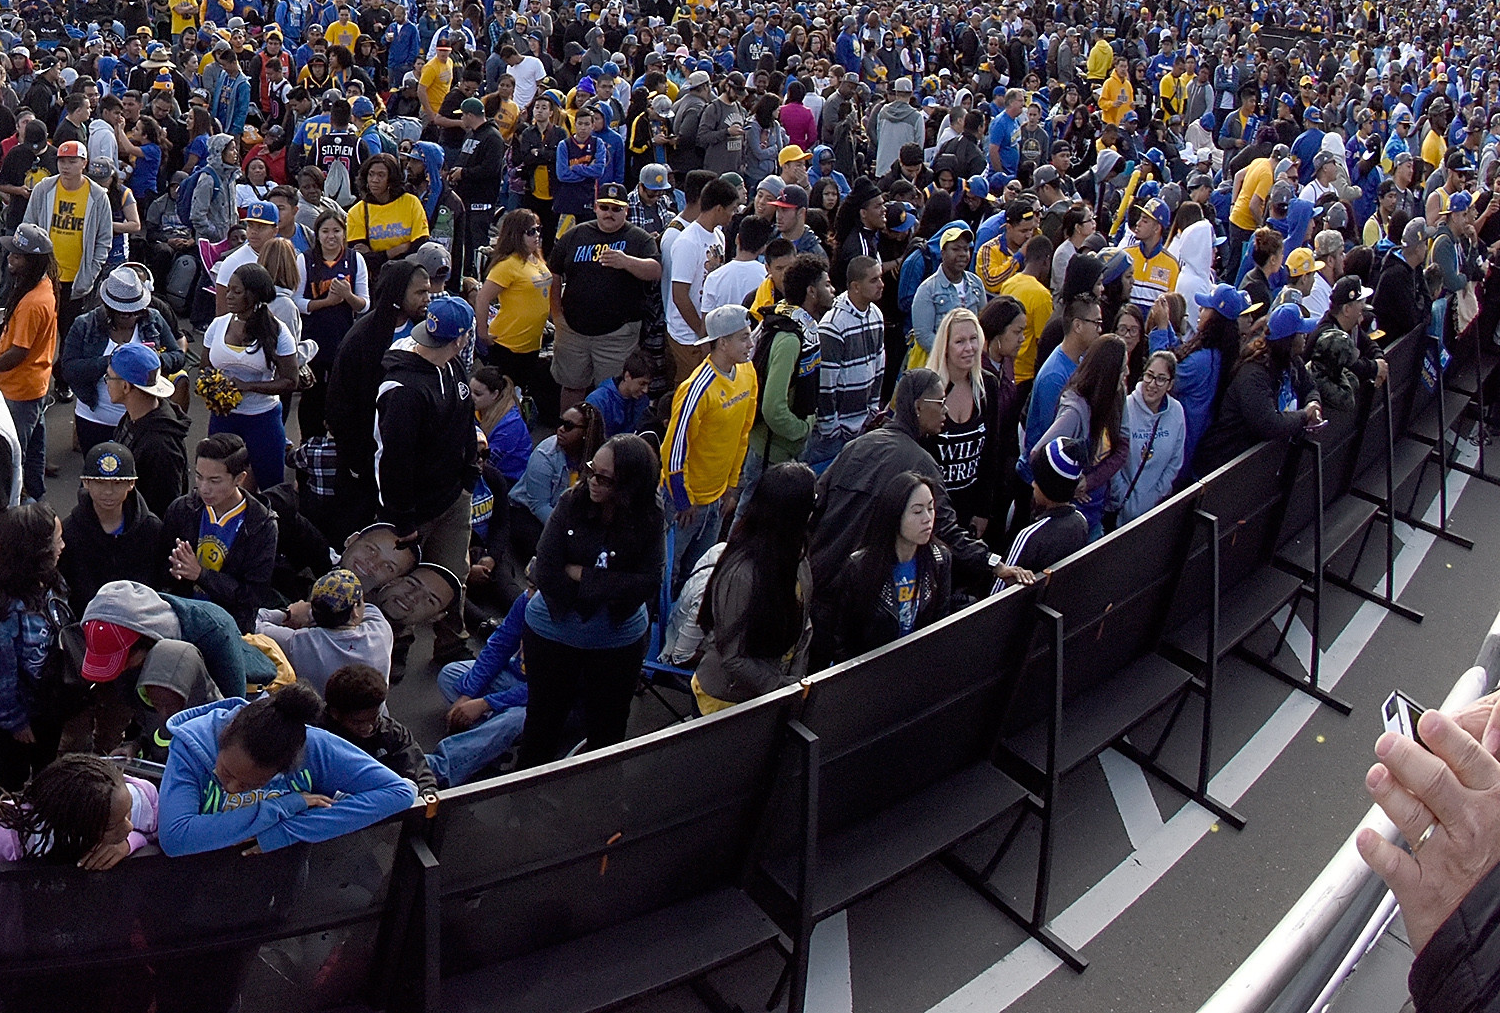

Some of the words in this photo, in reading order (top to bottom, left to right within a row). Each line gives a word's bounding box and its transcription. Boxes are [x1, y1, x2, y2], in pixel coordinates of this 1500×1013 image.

[322, 145, 353, 156] STEPHEN
[59, 201, 77, 215] WE
[1131, 431, 1170, 440] WARORS
